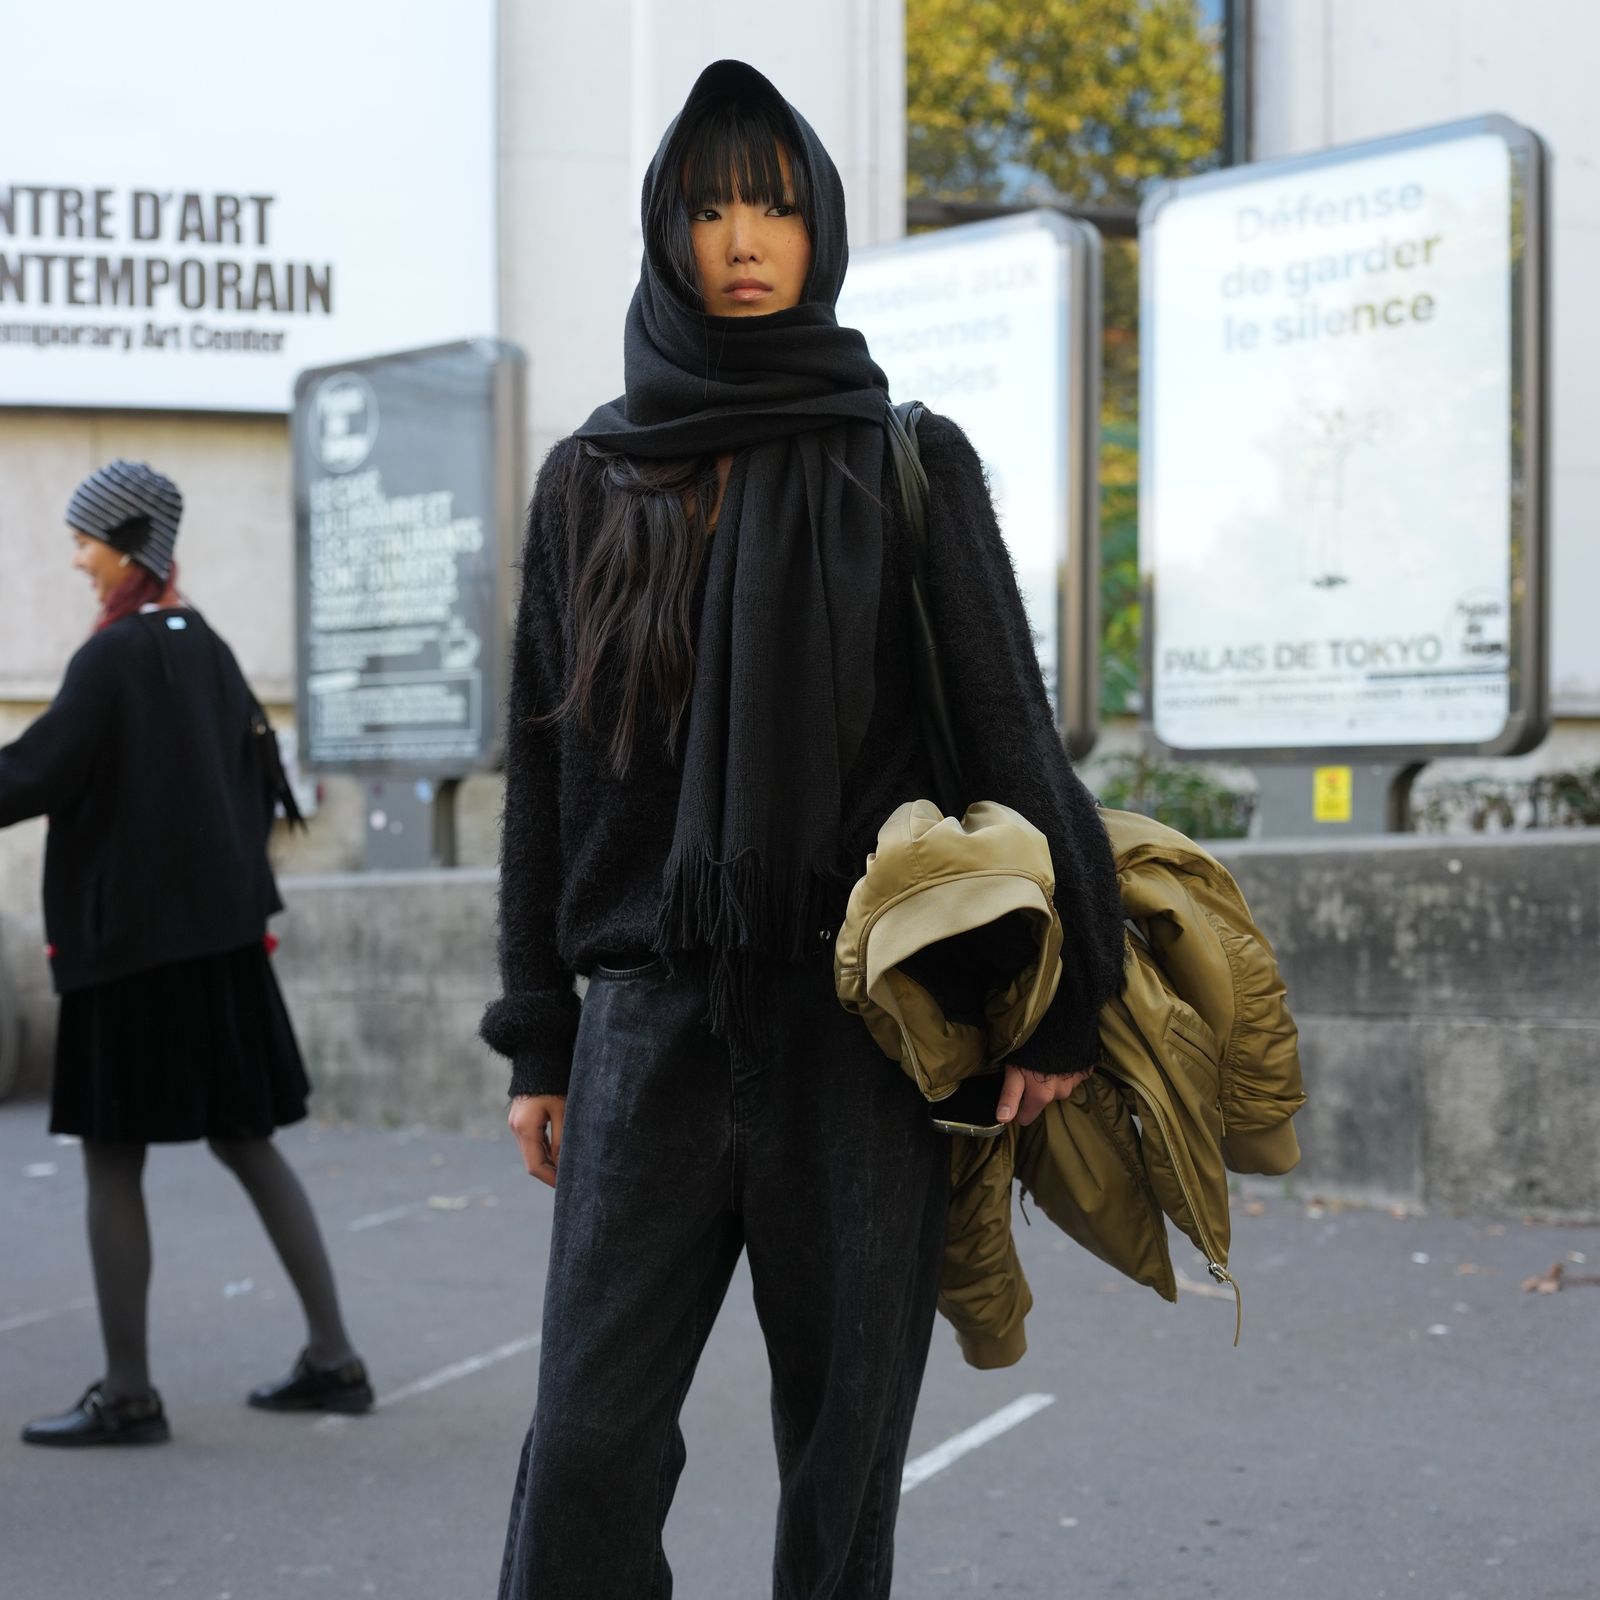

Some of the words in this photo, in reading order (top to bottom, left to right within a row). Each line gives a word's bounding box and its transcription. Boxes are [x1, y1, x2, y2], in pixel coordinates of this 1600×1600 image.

[0, 185, 115, 240] NTRE
[130, 189, 276, 246] D'ART
[1235, 181, 1425, 243] Défense
[0, 252, 332, 314] NTEMPORAIN
[1221, 263, 1272, 298] de
[1285, 232, 1443, 298] garder
[1223, 315, 1259, 352] le
[1273, 293, 1436, 345] silence
[1164, 642, 1266, 673] PALAIS
[1274, 641, 1317, 670] DE
[1330, 634, 1442, 668] TOKYO
